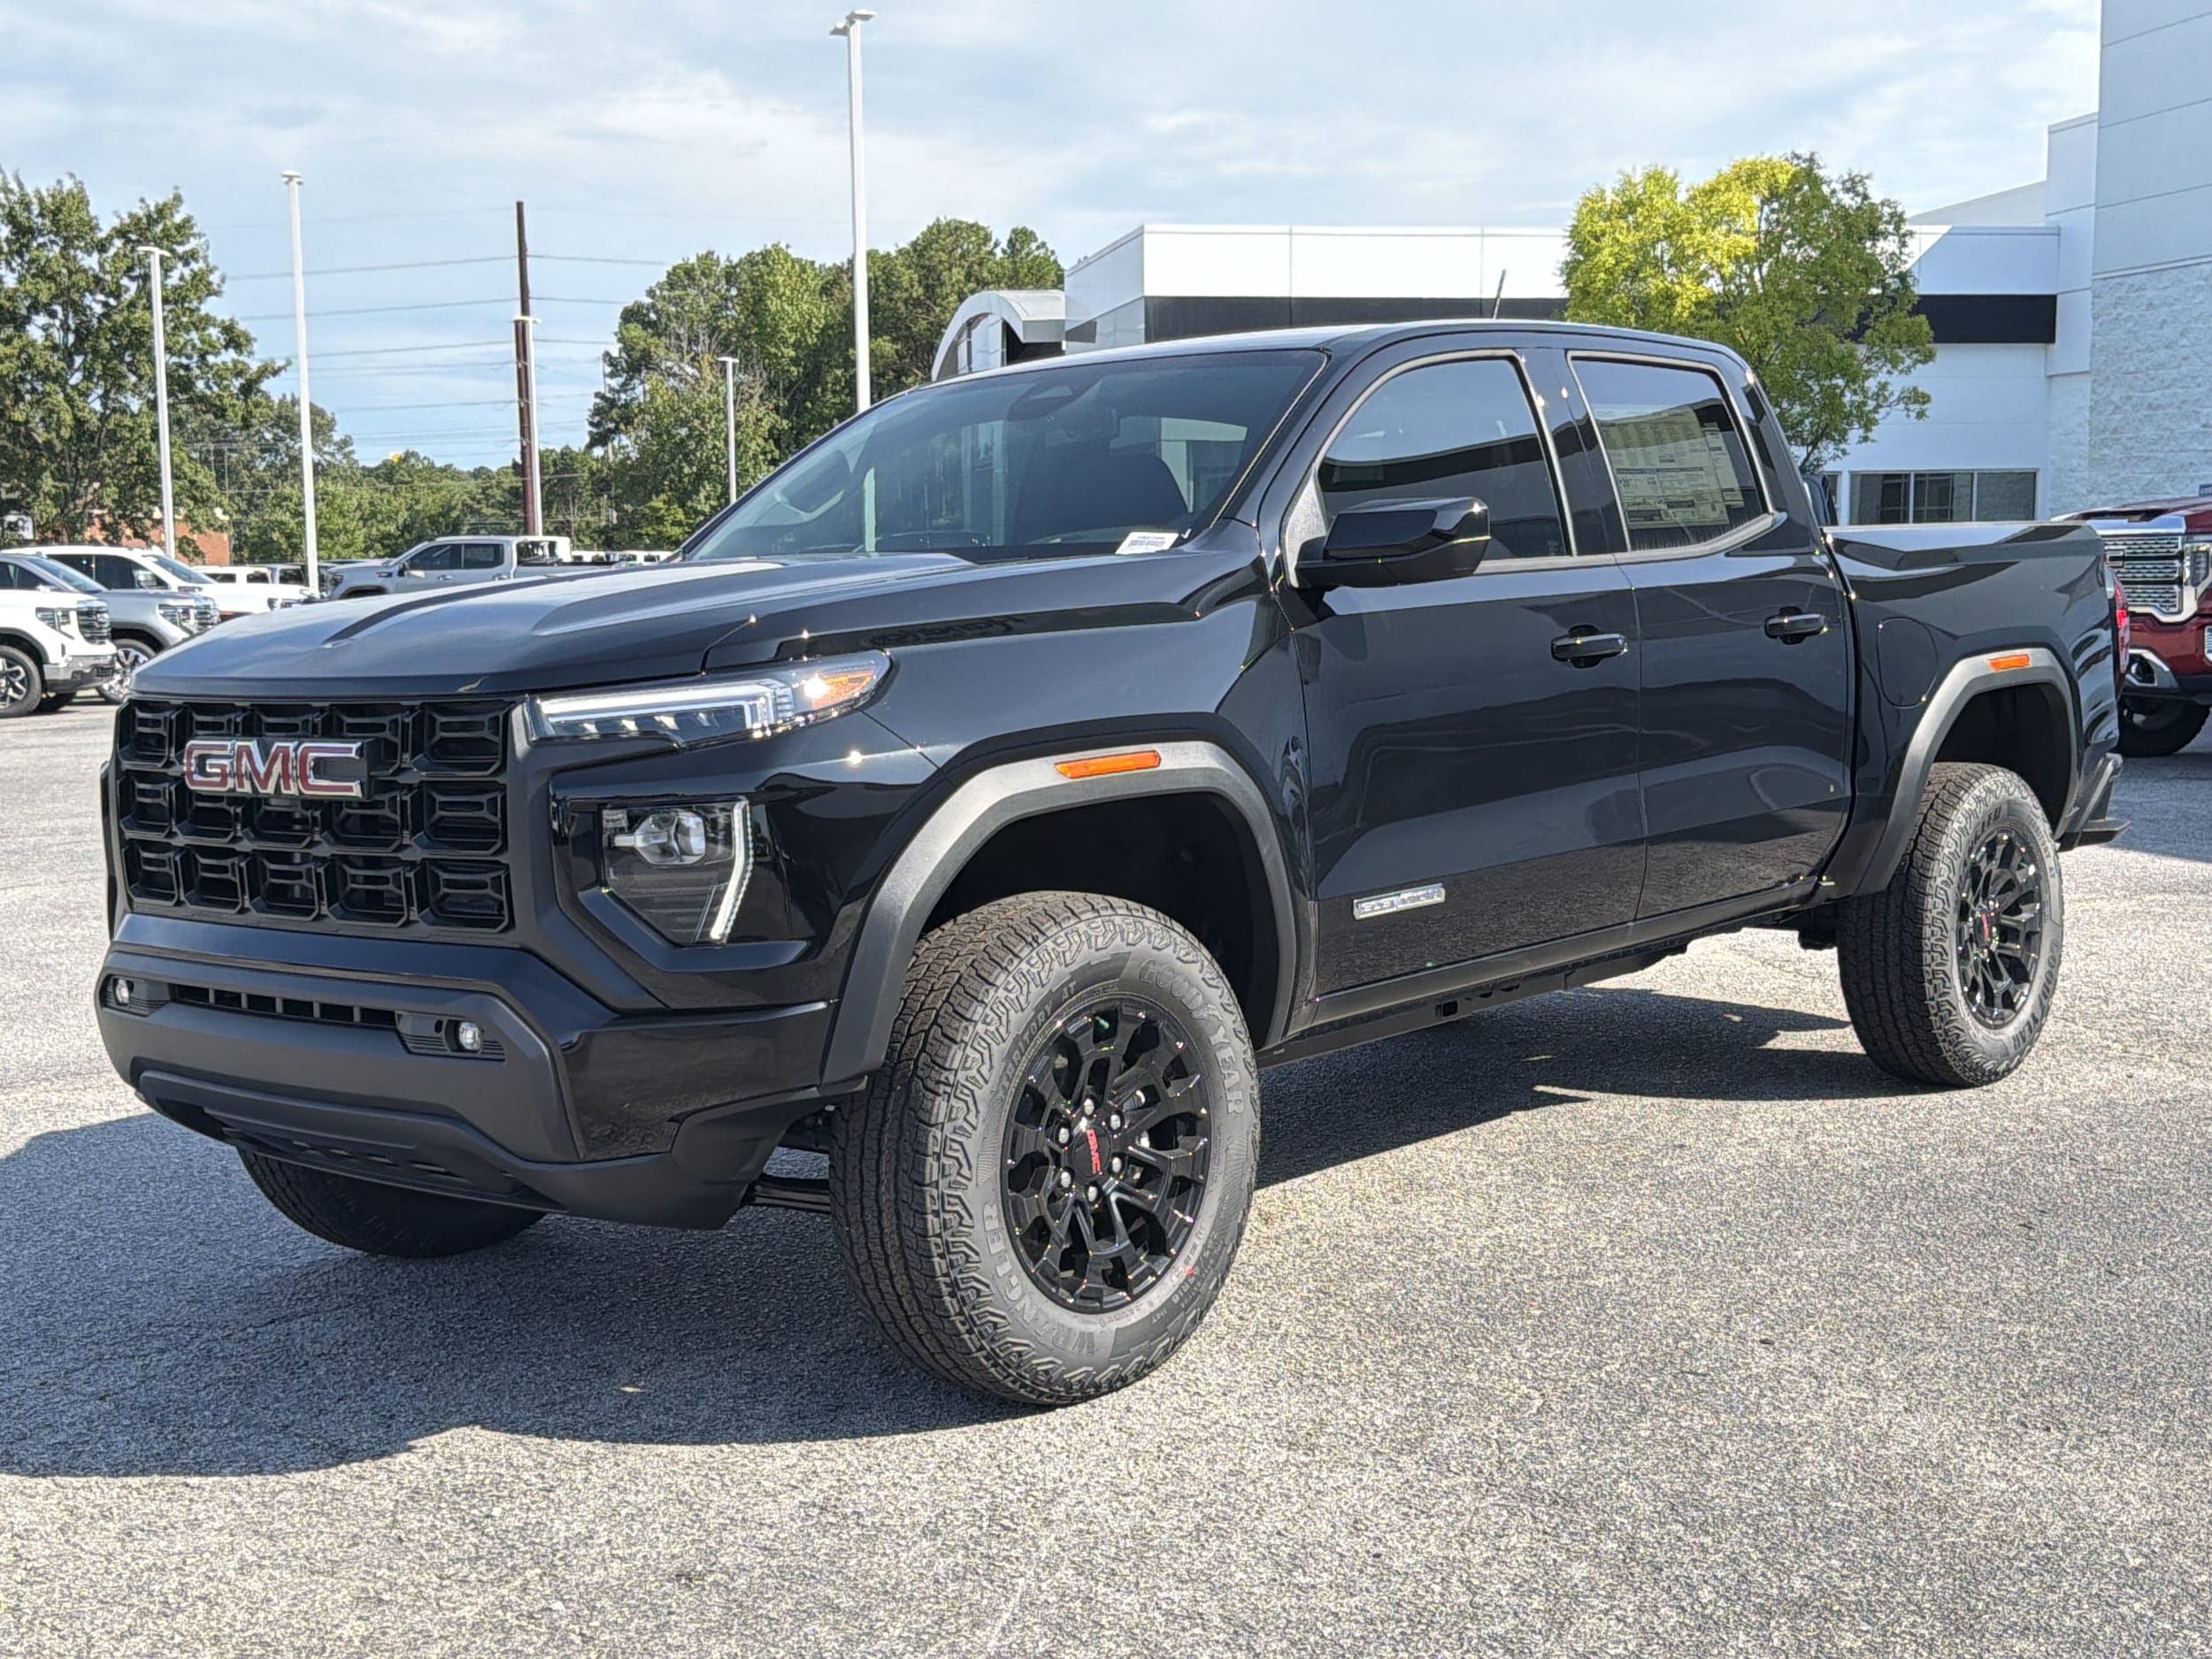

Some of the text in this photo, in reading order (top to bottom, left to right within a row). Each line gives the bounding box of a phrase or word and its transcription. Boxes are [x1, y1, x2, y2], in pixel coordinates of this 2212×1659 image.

[184, 740, 363, 797] GMC
[1140, 959, 1244, 1115] GOODYEAR
[983, 1202, 1095, 1356] WRANGLER
